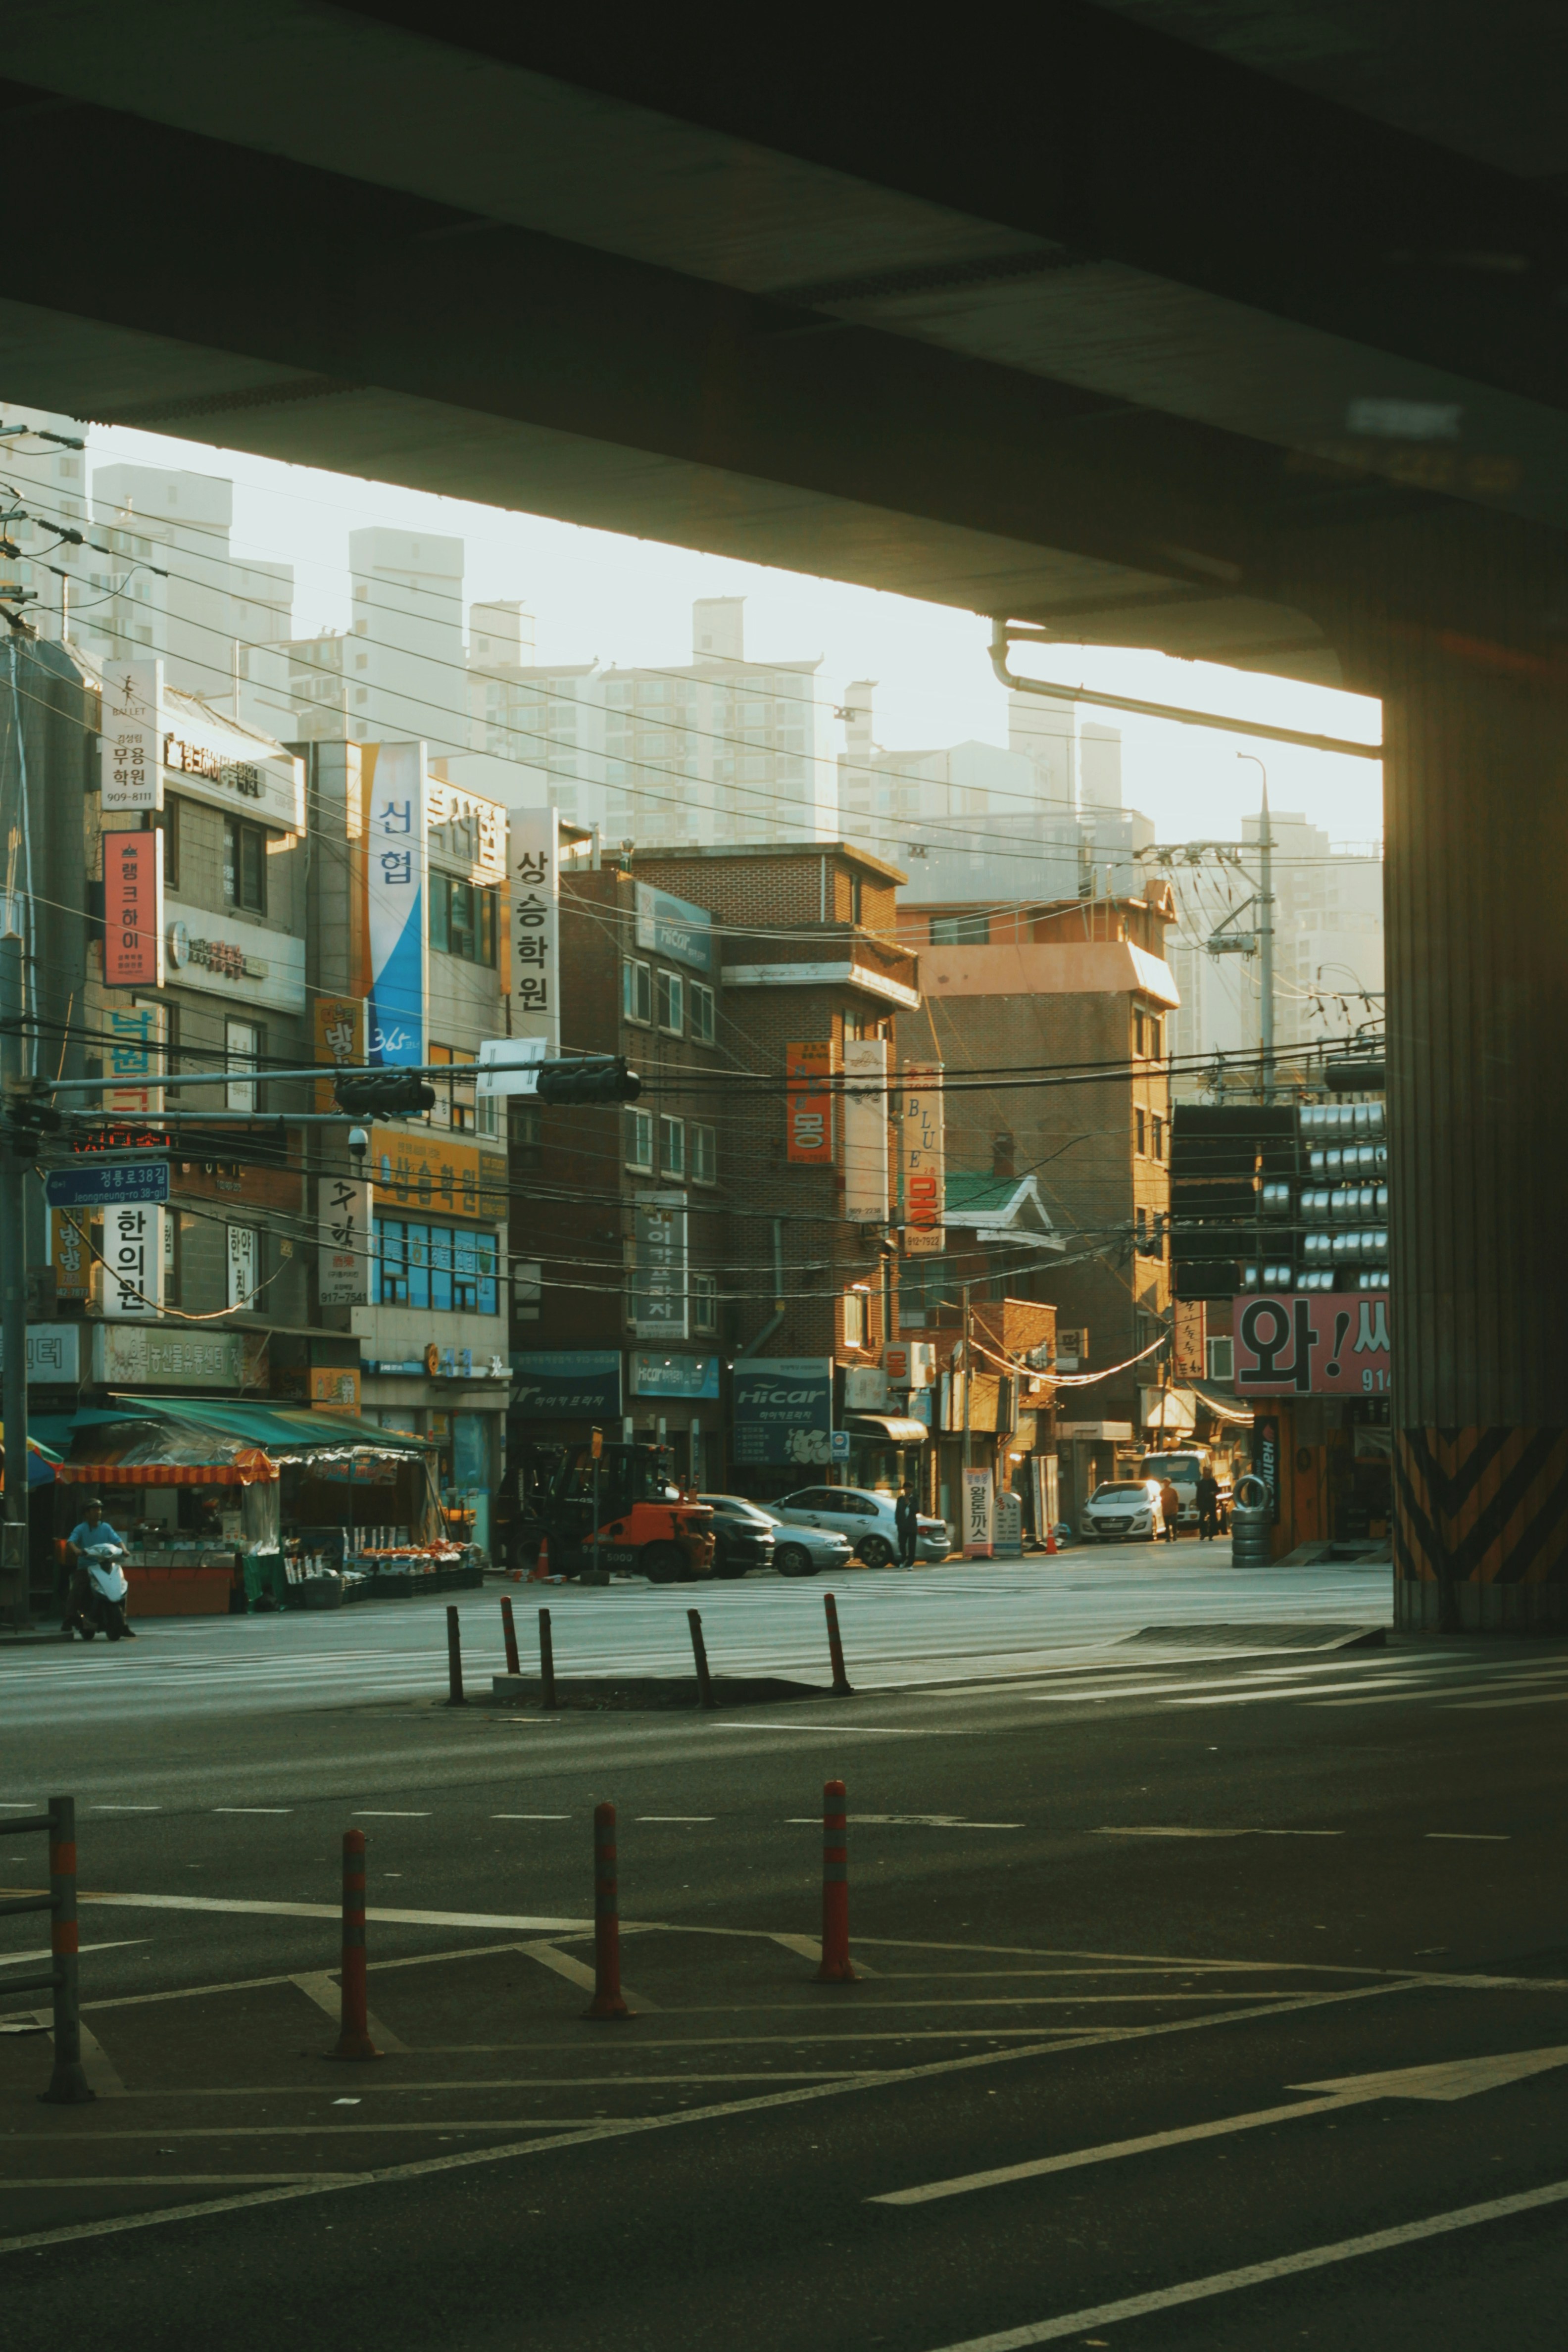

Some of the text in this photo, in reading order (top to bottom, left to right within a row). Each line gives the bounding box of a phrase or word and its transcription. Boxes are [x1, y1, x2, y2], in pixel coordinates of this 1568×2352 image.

[112, 707, 146, 716] BALLET
[113, 747, 145, 765] 무용
[113, 769, 146, 786] 학원
[107, 792, 151, 802] 909-8111
[379, 799, 412, 885] 신협
[122, 863, 138, 949] 랭크하이
[516, 850, 549, 1012] 상승학원
[368, 1027, 411, 1052] 365
[907, 1097, 935, 1169] BLUE
[100, 1166, 165, 1188] 정릉로38길
[395, 1156, 476, 1212] 상승학원
[73, 1187, 165, 1203] Jeongneung-ro 38-gil
[58, 1224, 81, 1272] 방방
[907, 1236, 939, 1246] 912-7922
[117, 1210, 147, 1310] 한의원
[321, 1292, 367, 1303] 917-7541
[128, 1339, 228, 1376] 우리농산물유통센터
[737, 1390, 827, 1404] Hicar
[759, 1411, 812, 1420] 하이카프라자
[1262, 1441, 1275, 1518] Hank
[970, 1486, 987, 1543] 왕돈까스
[607, 1553, 633, 1562] 5000
